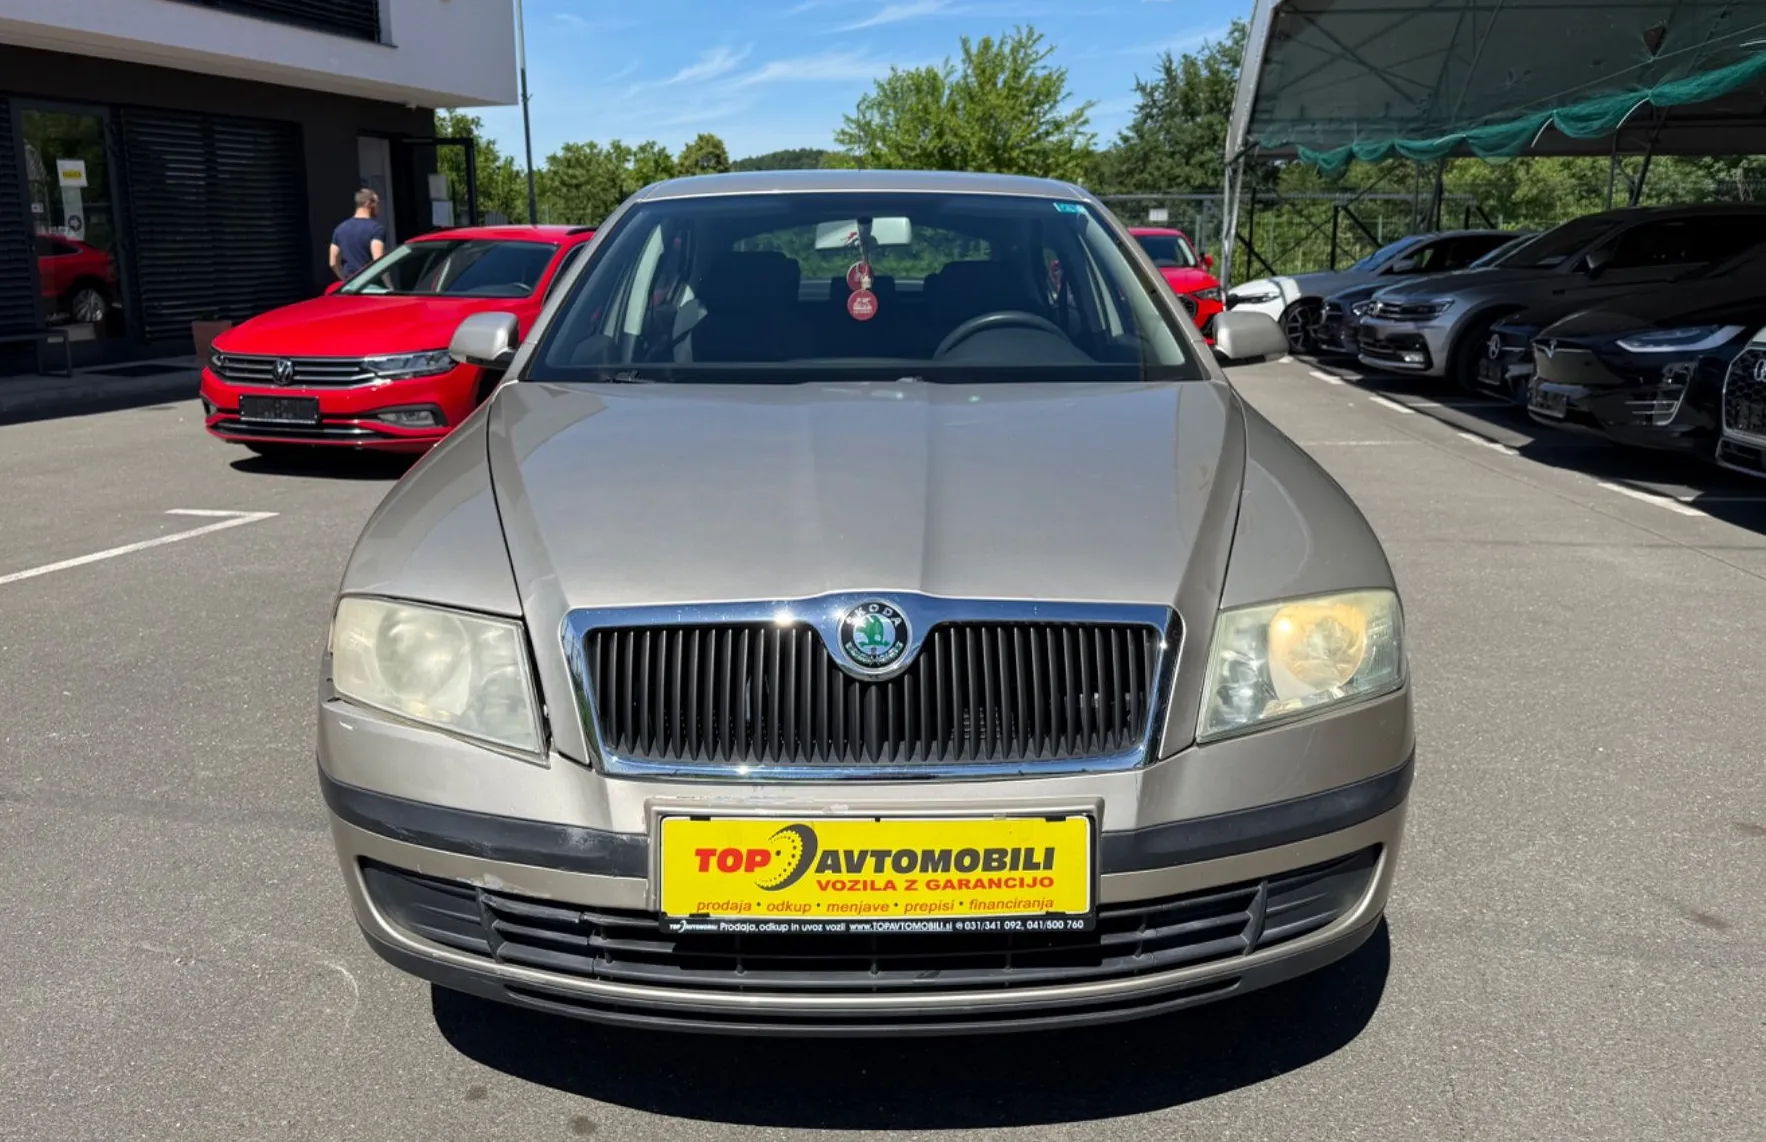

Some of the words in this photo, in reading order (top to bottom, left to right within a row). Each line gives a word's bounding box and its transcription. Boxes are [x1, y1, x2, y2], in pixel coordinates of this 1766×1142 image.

[695, 847, 772, 873] TOP
[815, 847, 1055, 874] AVTOMOBILI
[816, 880, 897, 892] VOZILA
[904, 879, 918, 891] Z
[925, 876, 1054, 891] GARANCIJO
[696, 900, 752, 912] prodaja
[766, 900, 812, 913] odkup
[826, 901, 889, 914] menjave
[904, 900, 955, 914] prepisi
[969, 897, 1054, 912] financiranja
[1066, 920, 1084, 929] 760
